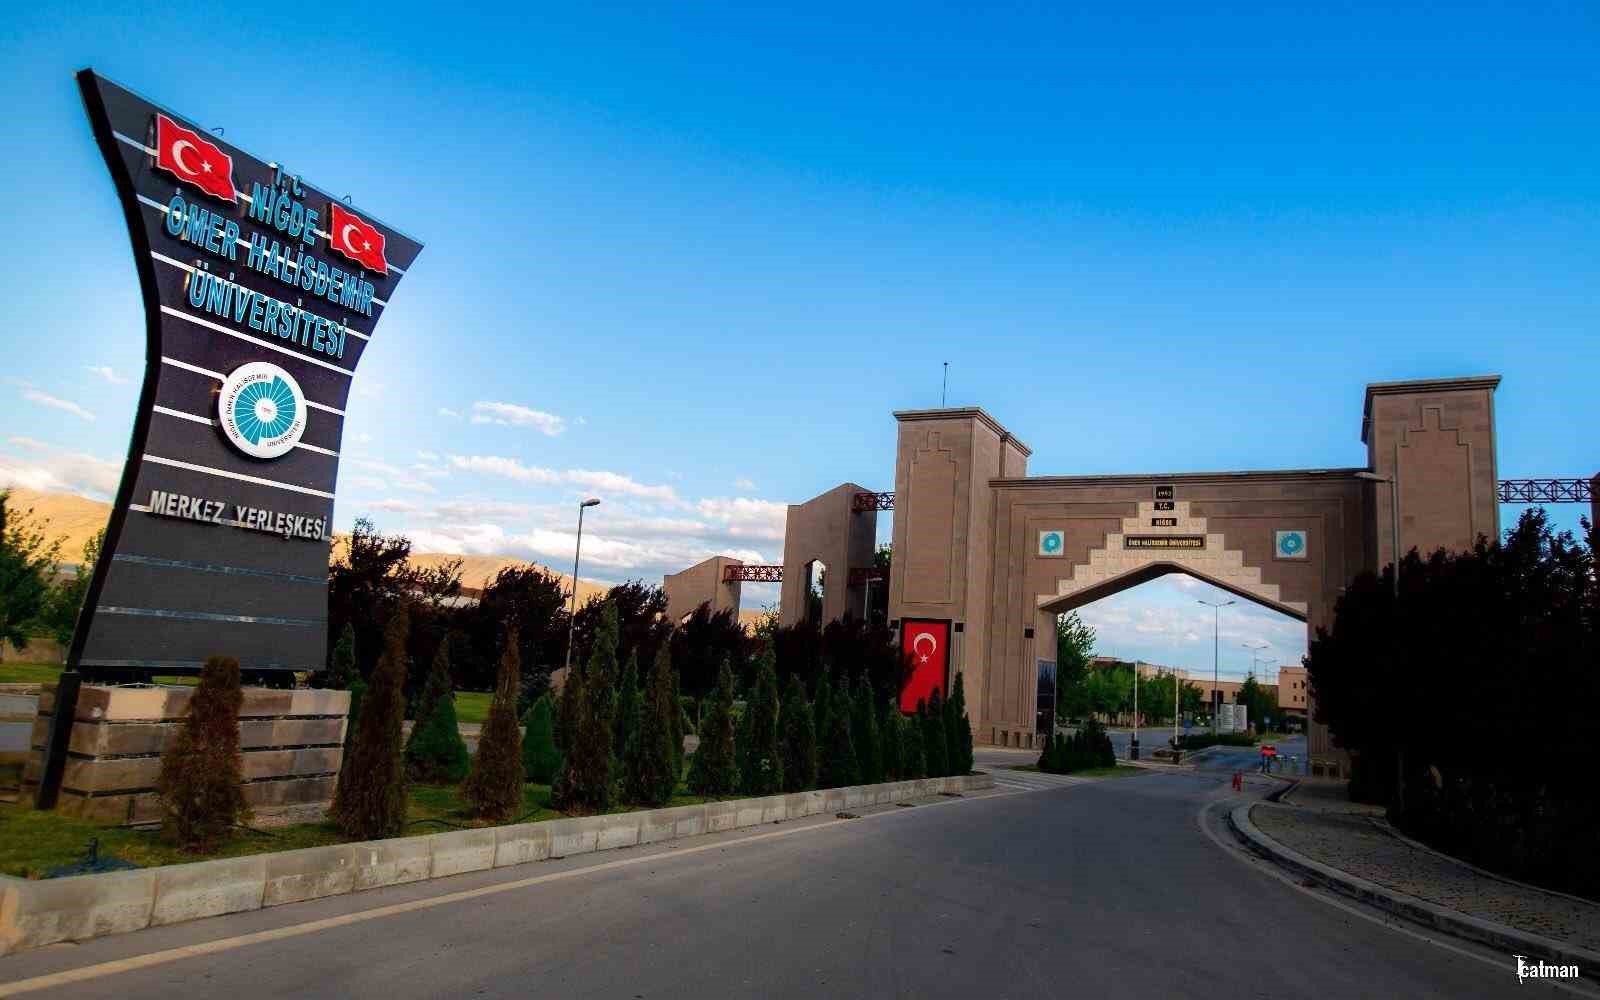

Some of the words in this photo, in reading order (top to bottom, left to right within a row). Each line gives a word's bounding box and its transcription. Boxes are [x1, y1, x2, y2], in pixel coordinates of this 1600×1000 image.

[166, 188, 240, 261] ÖMER
[249, 182, 320, 246] NİĞDE
[189, 261, 348, 359] ÜNİVERSİTESİ
[149, 490, 226, 524] MERKEZ
[236, 504, 328, 540] YERLEŞKESİ
